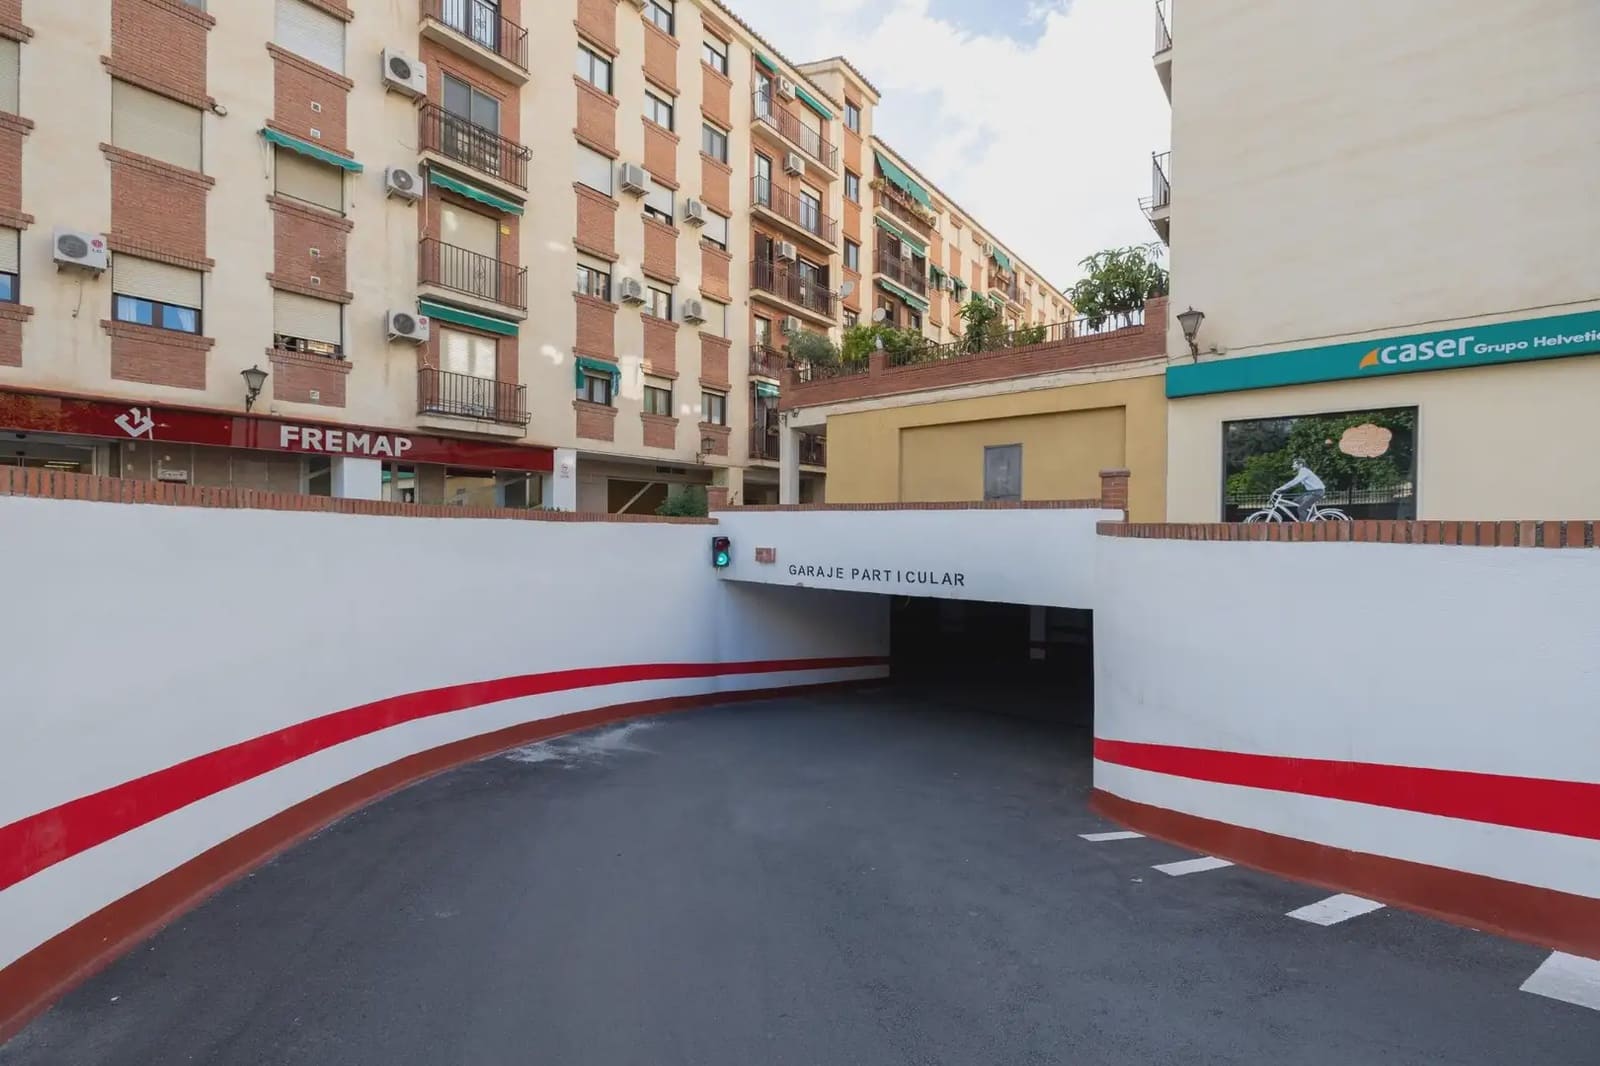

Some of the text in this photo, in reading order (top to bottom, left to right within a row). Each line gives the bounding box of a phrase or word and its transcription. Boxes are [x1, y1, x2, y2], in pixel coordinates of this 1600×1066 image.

[1380, 336, 1475, 364] caser
[1473, 341, 1528, 354] Grupo
[280, 425, 412, 457] FREMAP
[788, 564, 965, 586] GARAJE PARTICULAR
